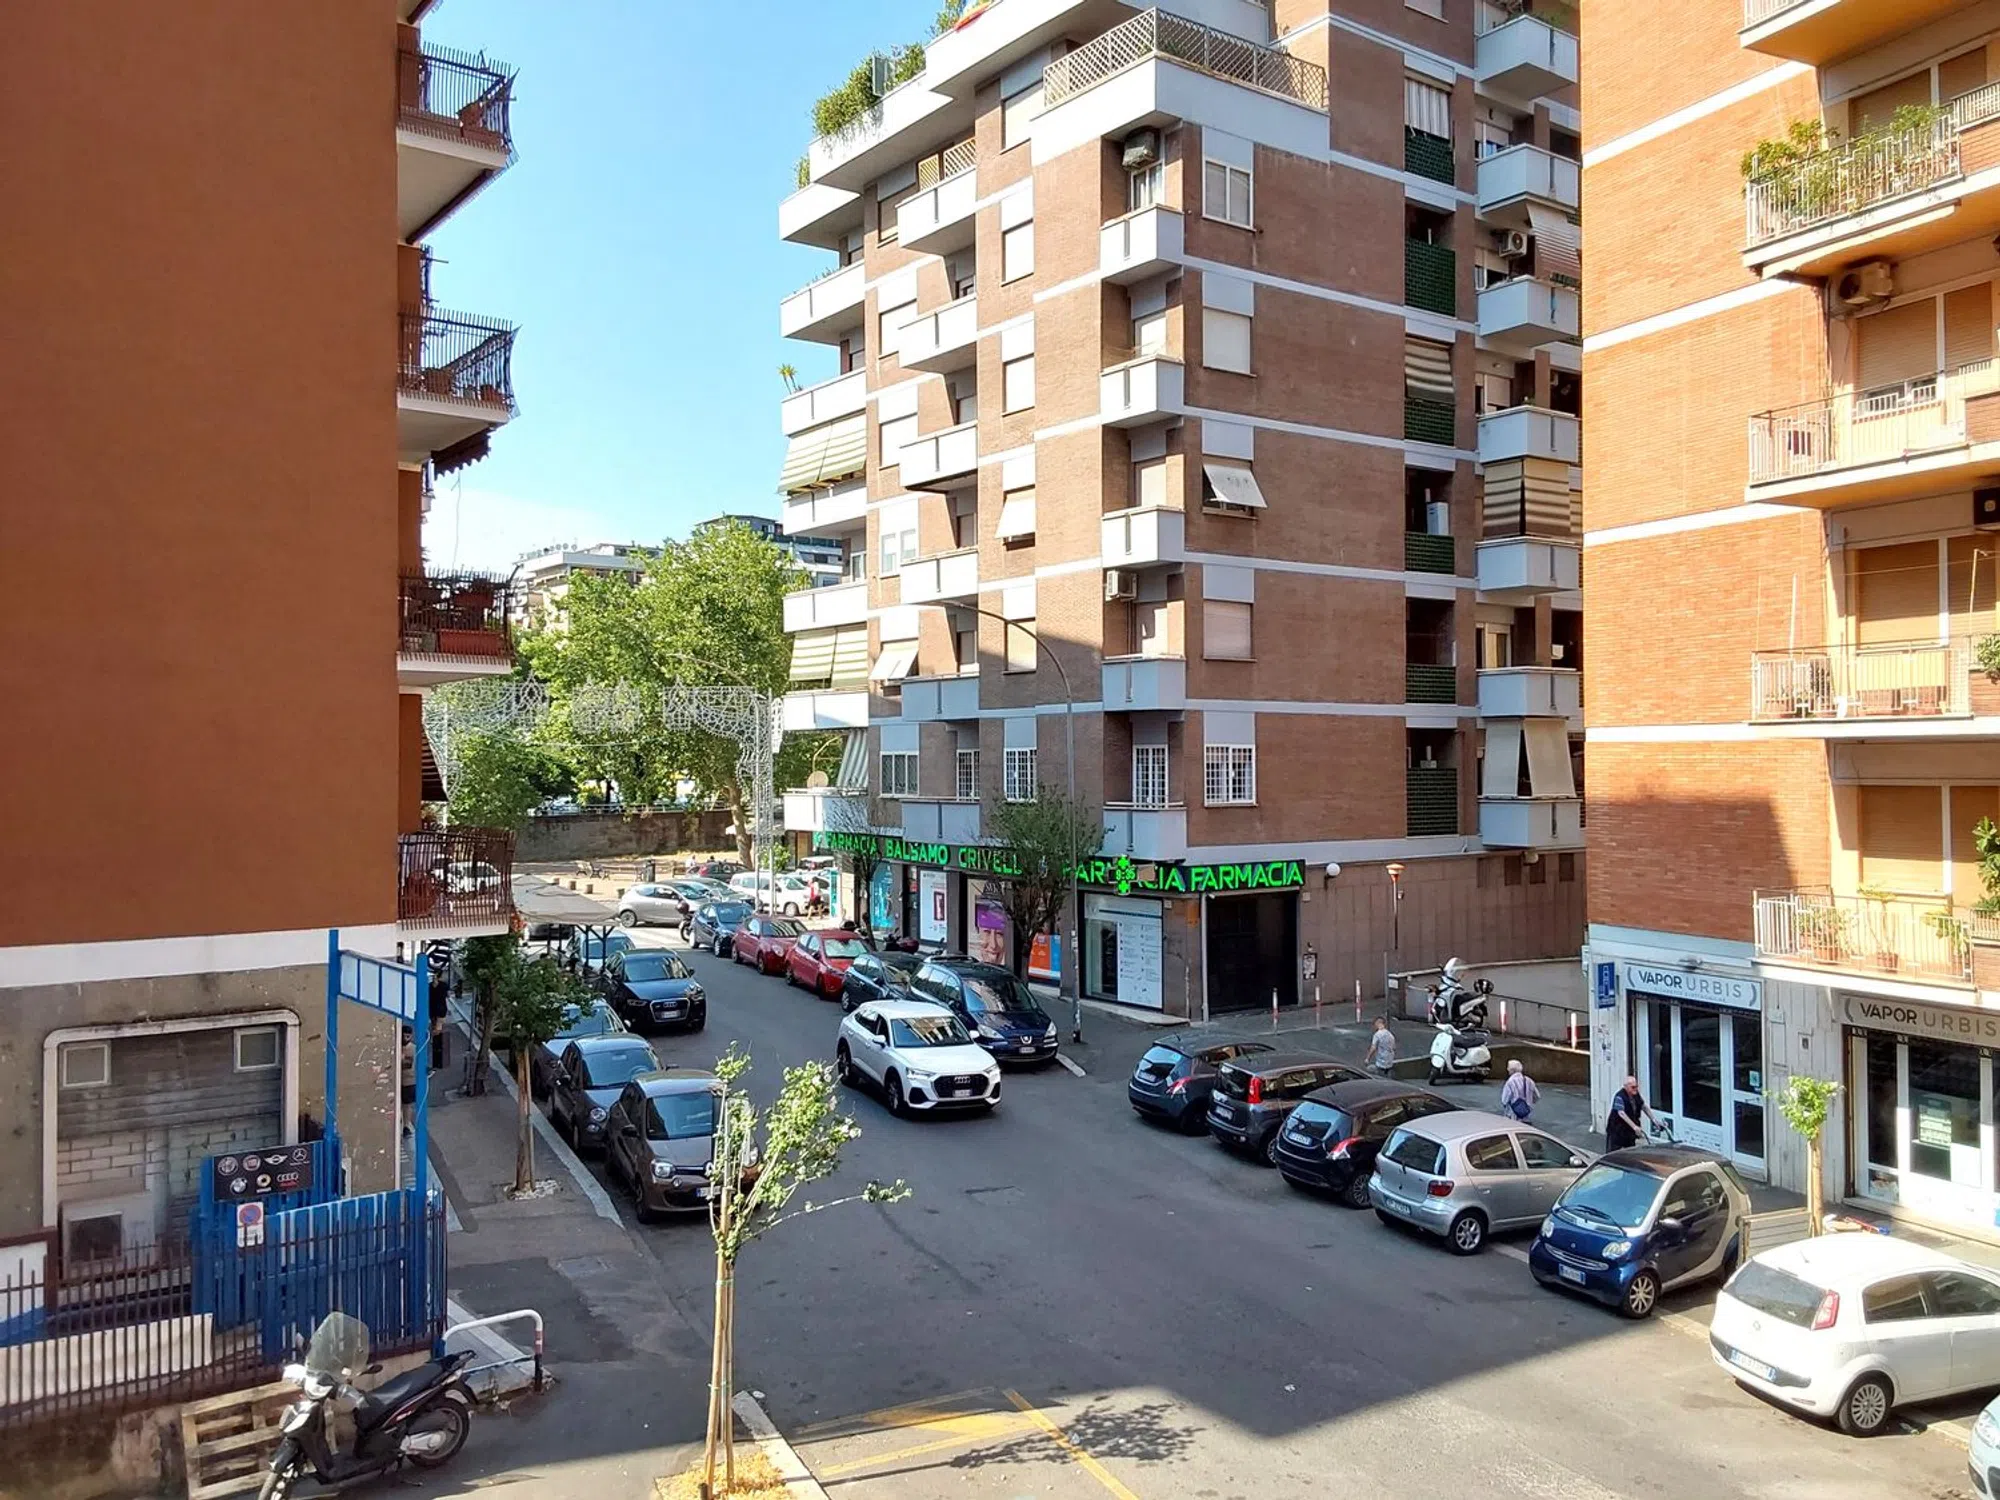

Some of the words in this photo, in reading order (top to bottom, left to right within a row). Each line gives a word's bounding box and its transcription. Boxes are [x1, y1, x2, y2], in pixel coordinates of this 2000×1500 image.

[826, 831, 878, 855] FARMACIA
[885, 839, 949, 866] BALSAMO
[1190, 861, 1304, 892] FARMACIA
[1638, 970, 1683, 989] VAPOR
[1686, 976, 1742, 998] URBIS
[1860, 1002, 1917, 1025] VAPOR
[1923, 1010, 1998, 1037] URBIS
